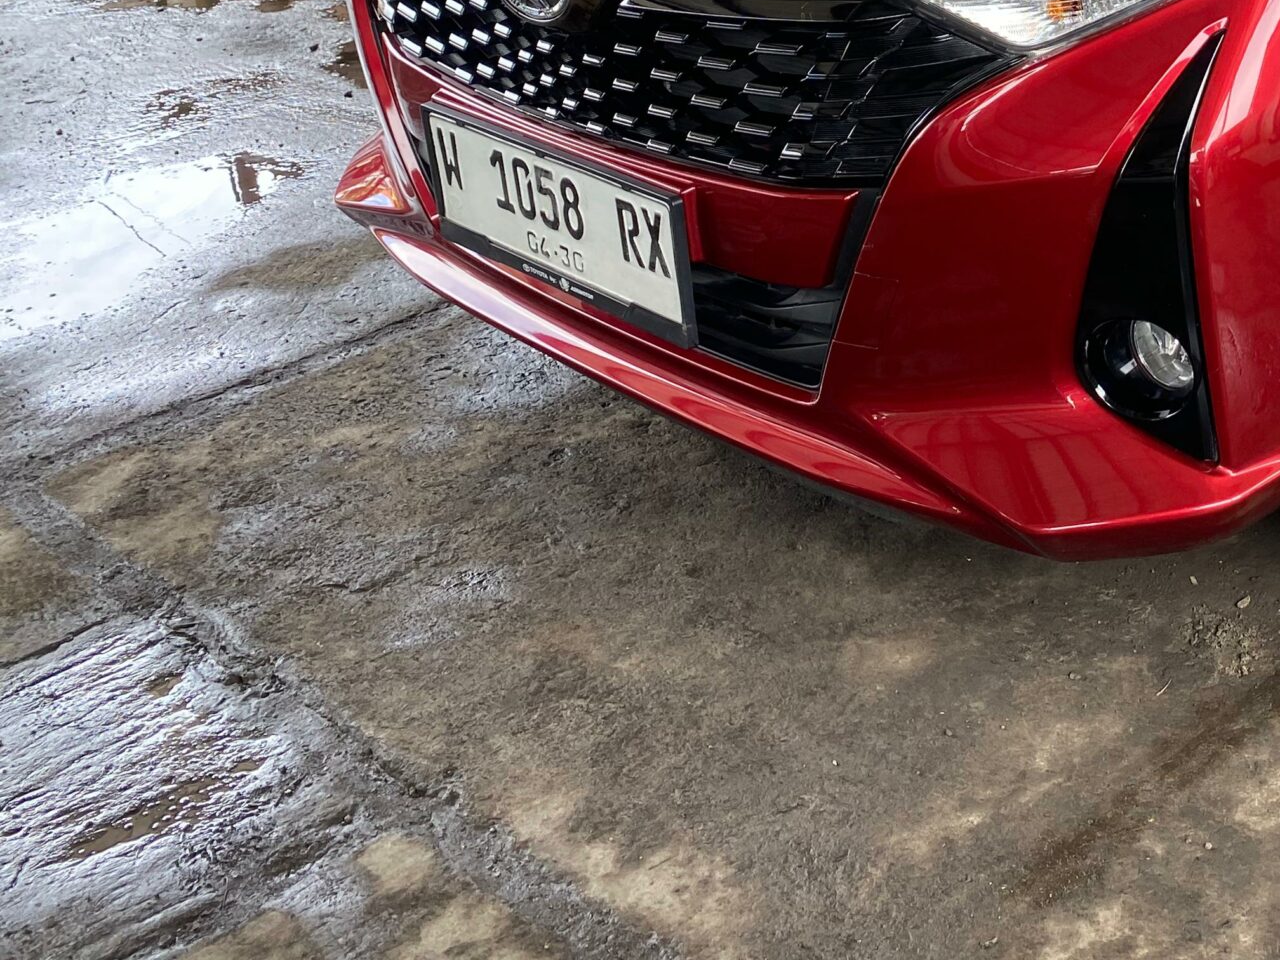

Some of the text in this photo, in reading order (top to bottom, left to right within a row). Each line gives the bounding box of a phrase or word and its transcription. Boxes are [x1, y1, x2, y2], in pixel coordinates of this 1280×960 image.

[437, 127, 671, 279] W 1058 RX
[529, 266, 549, 280] TOYOTA
